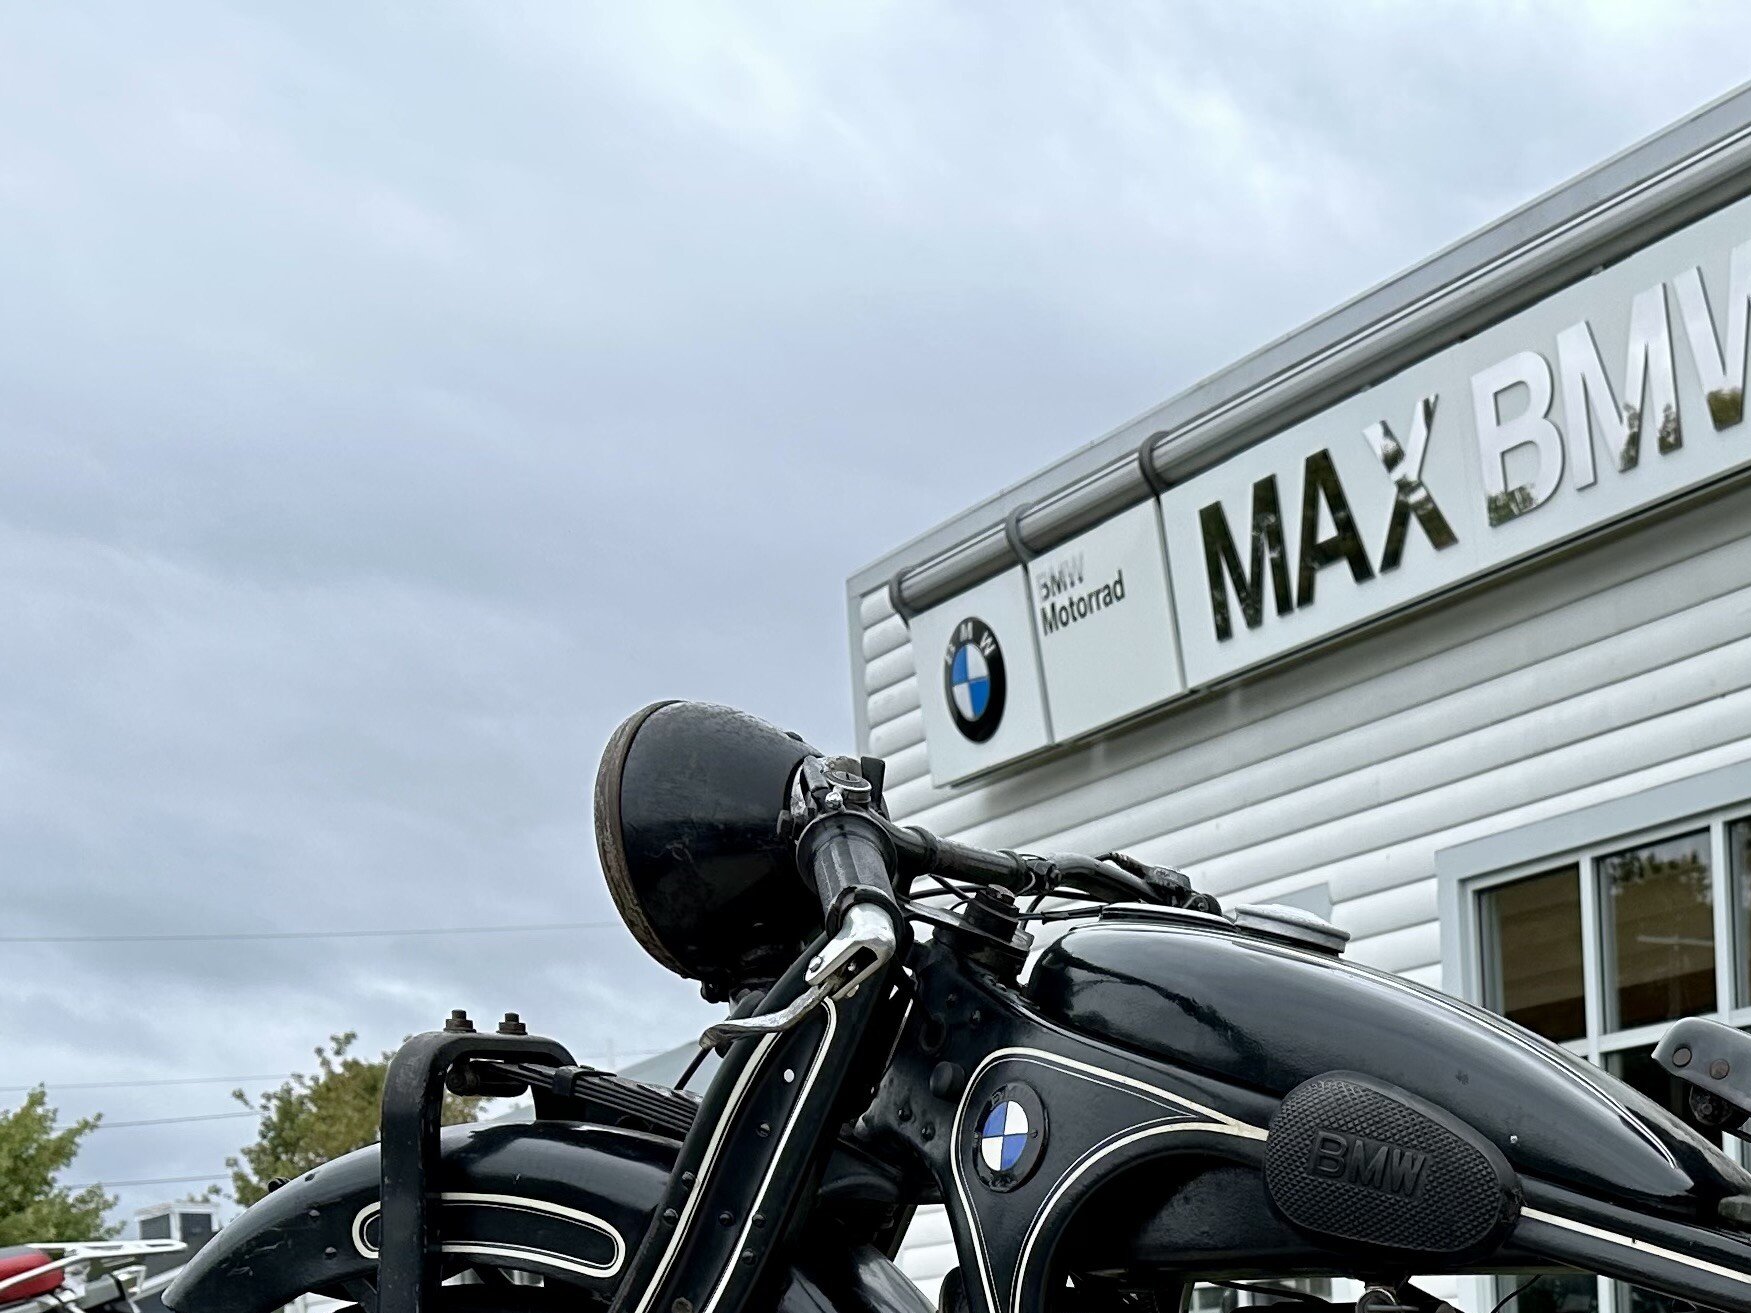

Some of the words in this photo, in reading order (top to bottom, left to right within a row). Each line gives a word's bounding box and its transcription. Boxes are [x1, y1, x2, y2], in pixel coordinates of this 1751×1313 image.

[1199, 393, 1459, 642] MAX
[1036, 553, 1084, 602] BMW
[1041, 568, 1125, 636] Motorrad
[945, 620, 997, 666] BMW
[1311, 1131, 1426, 1196] BMW
